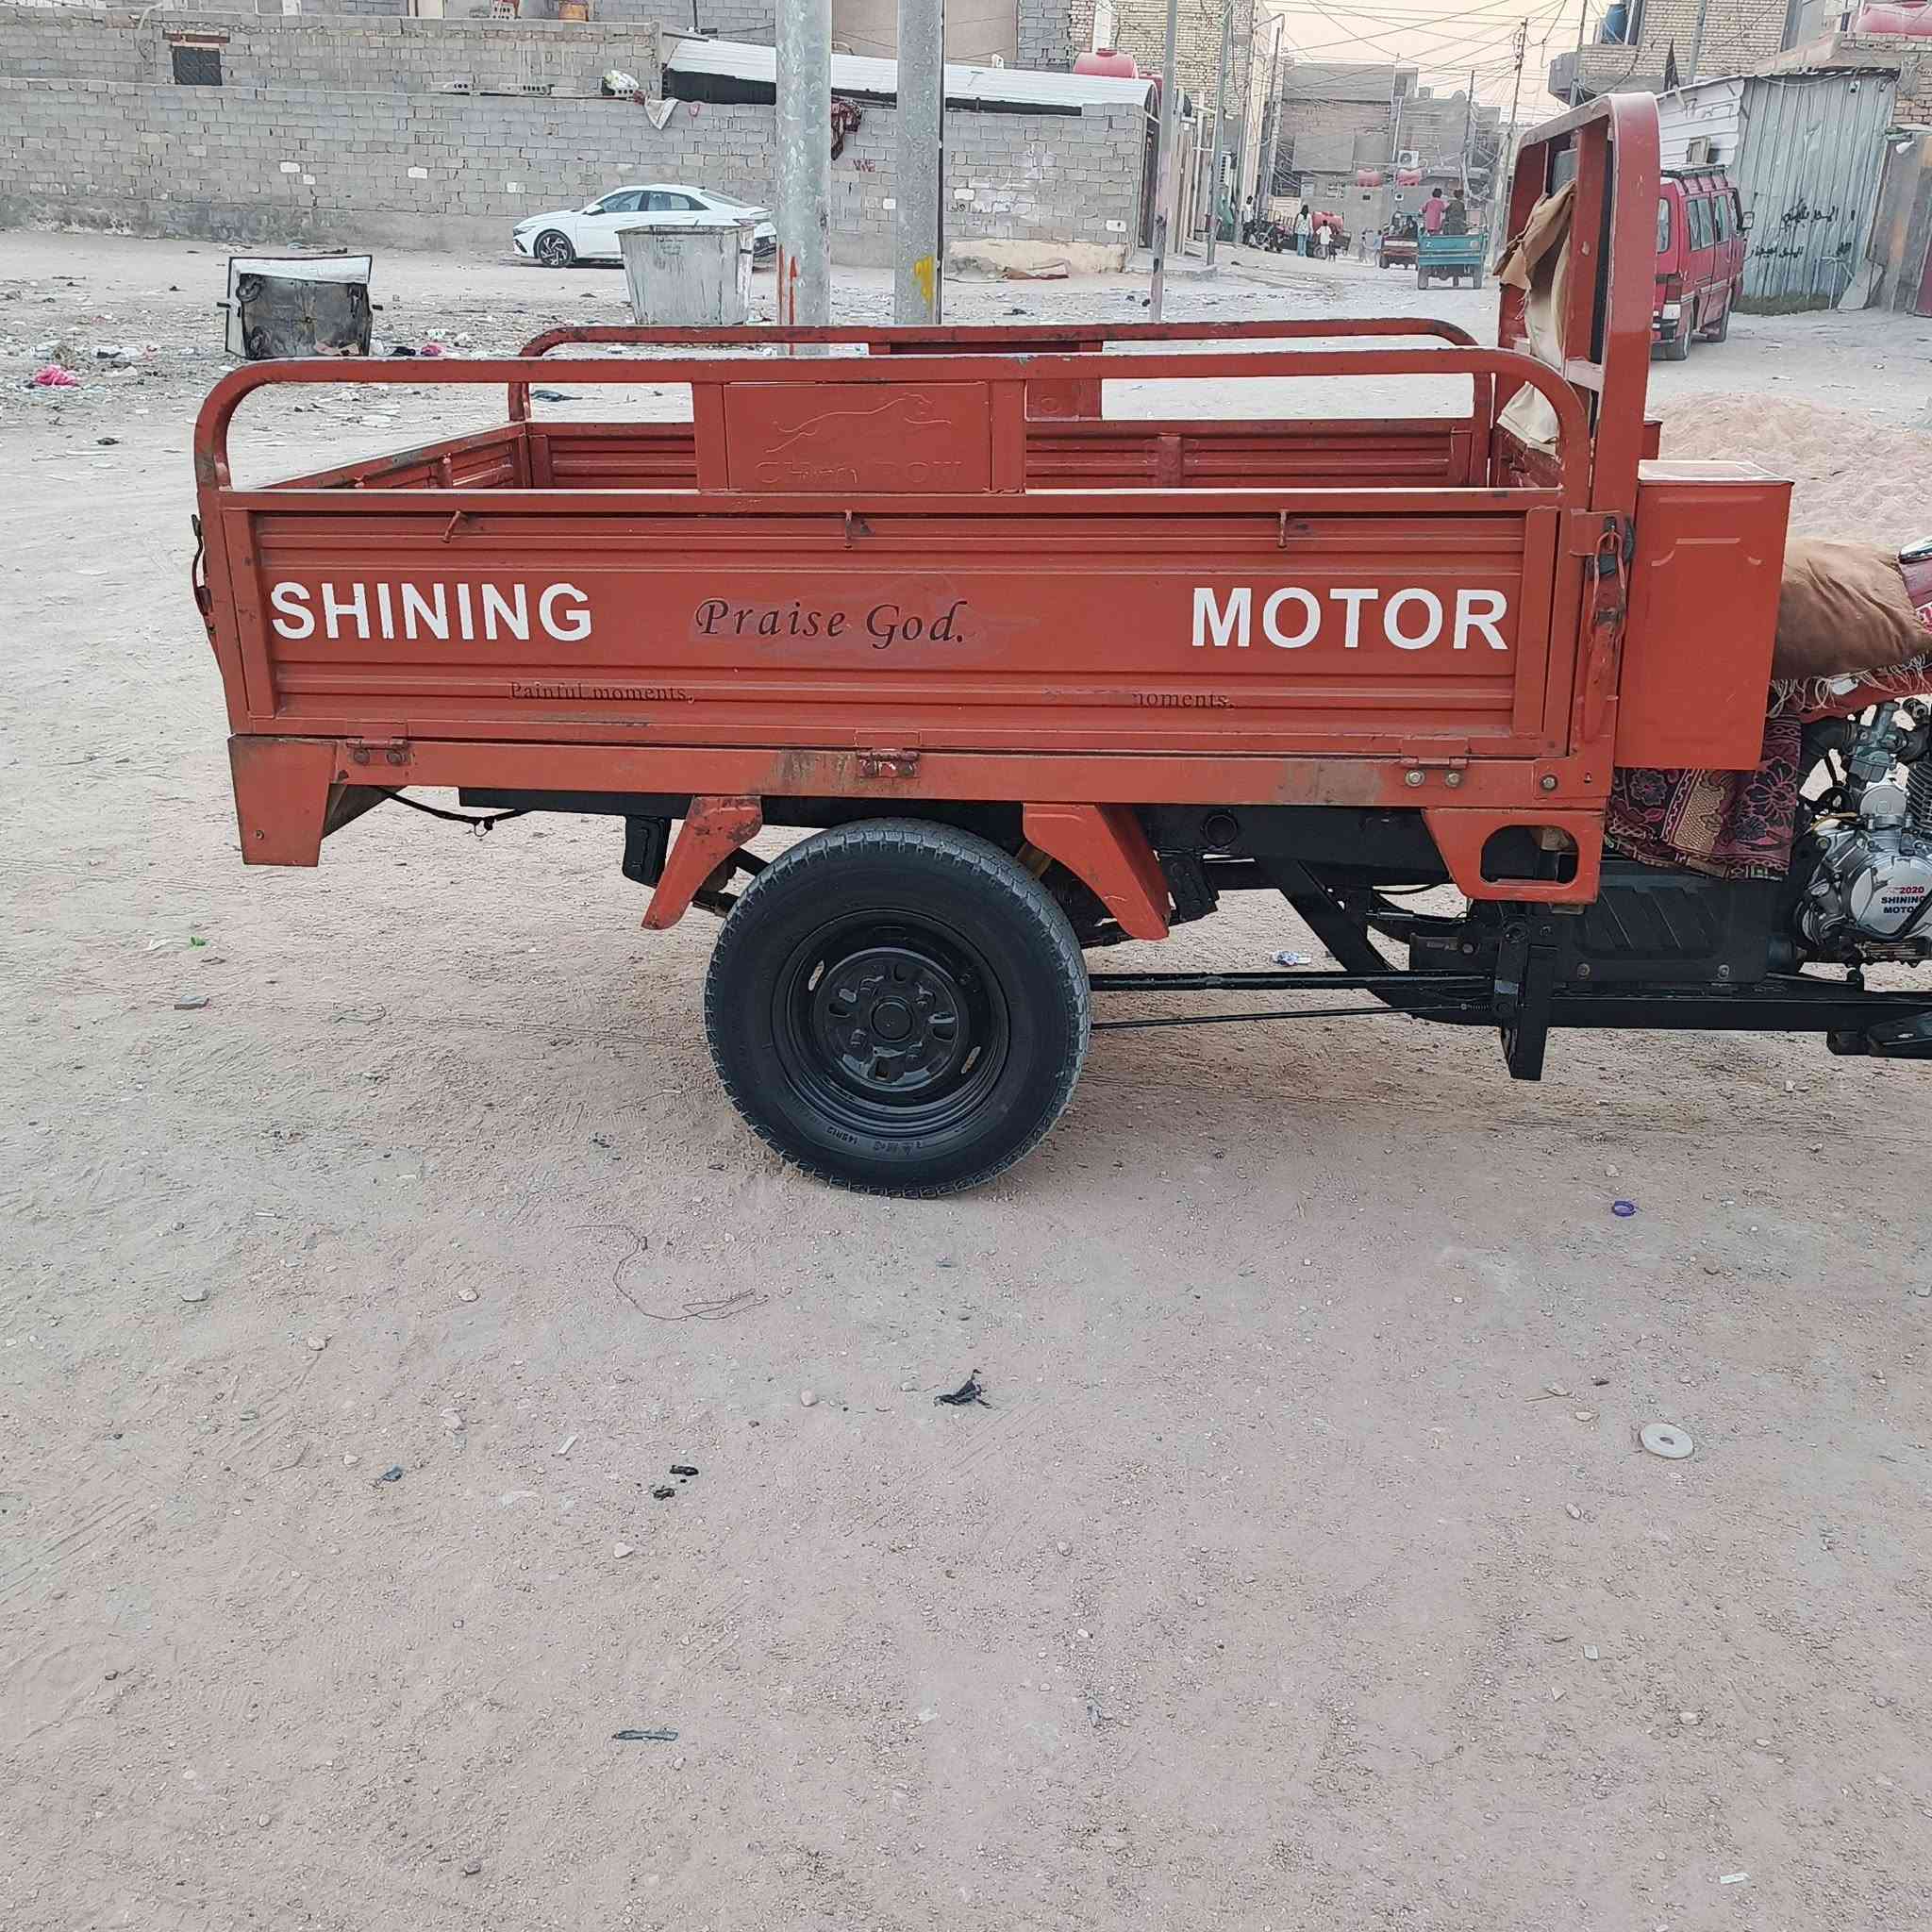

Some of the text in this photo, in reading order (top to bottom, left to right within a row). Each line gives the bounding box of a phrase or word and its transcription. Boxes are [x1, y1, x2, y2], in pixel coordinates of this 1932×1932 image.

[271, 581, 591, 641] SHINING
[694, 596, 968, 650] Praise God.
[1191, 587, 1508, 650] MOTOR
[510, 681, 582, 699] Painful
[1900, 886, 1925, 894] 2020
